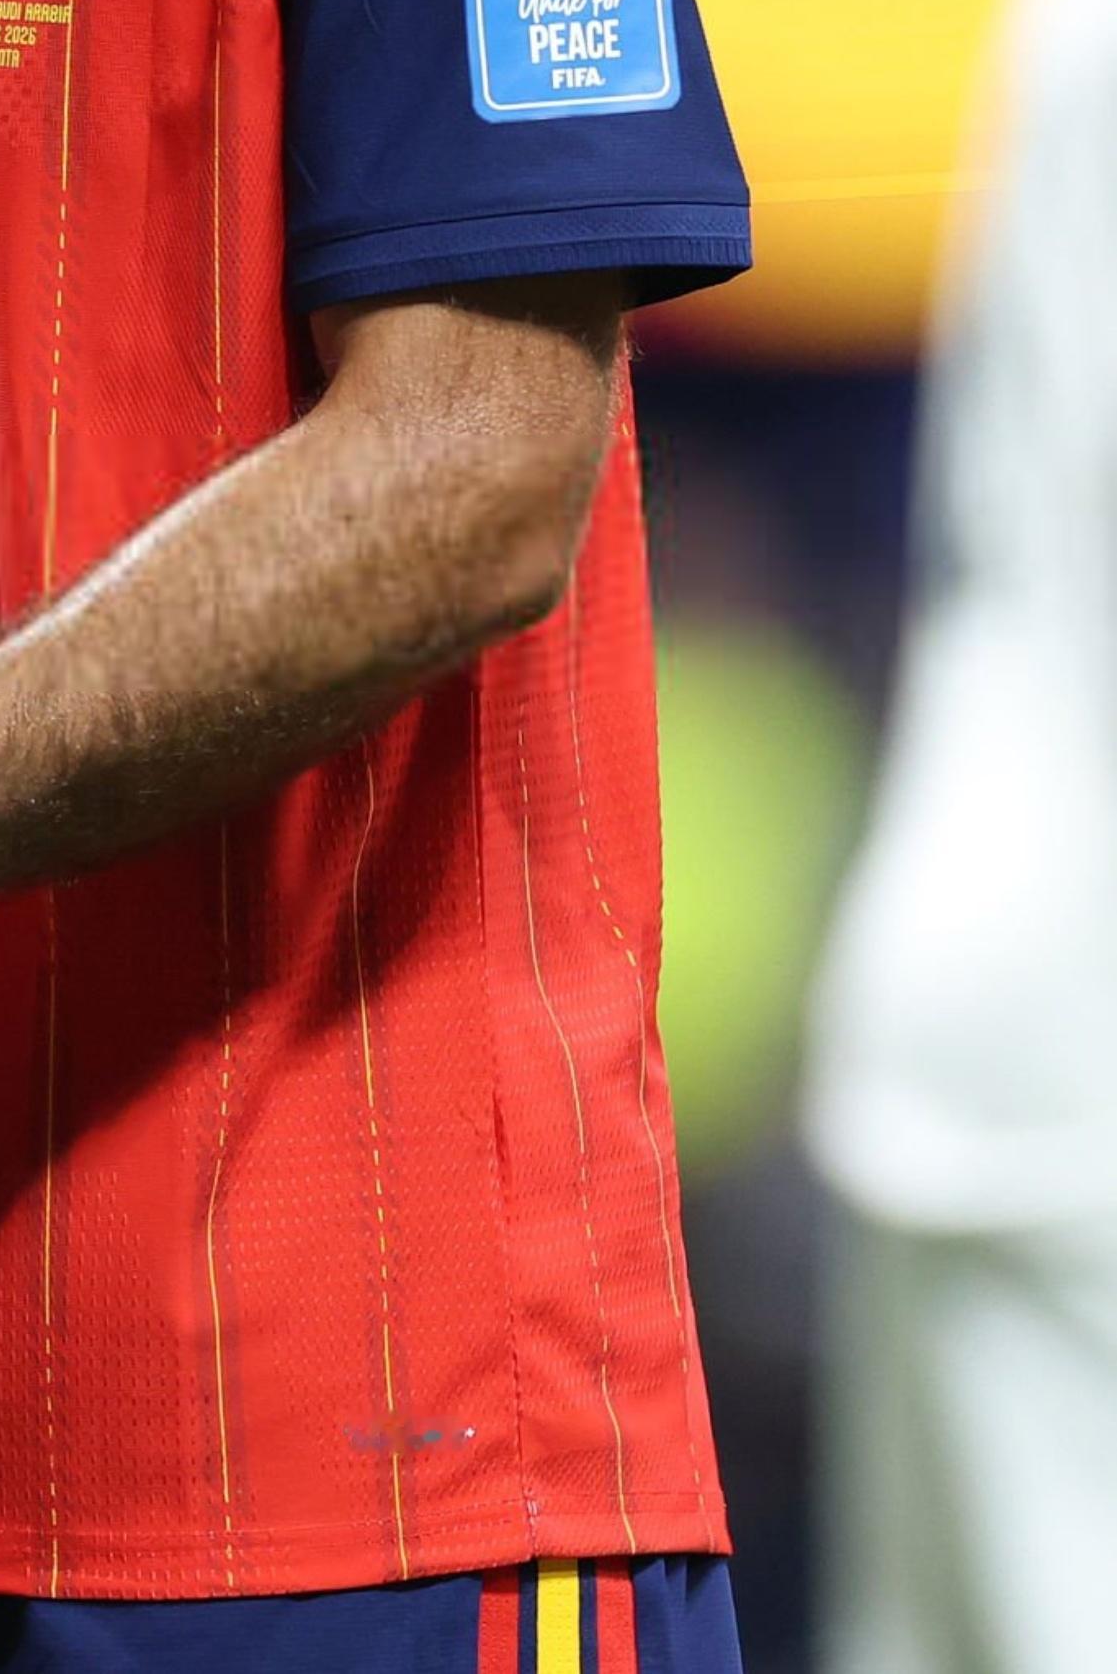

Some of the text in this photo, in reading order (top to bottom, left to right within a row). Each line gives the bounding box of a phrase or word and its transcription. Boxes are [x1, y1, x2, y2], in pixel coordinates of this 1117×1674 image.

[25, 3, 72, 23] ARABIA
[4, 26, 37, 45] 2026
[529, 18, 621, 64] PEACE
[551, 67, 606, 89] FIFA
